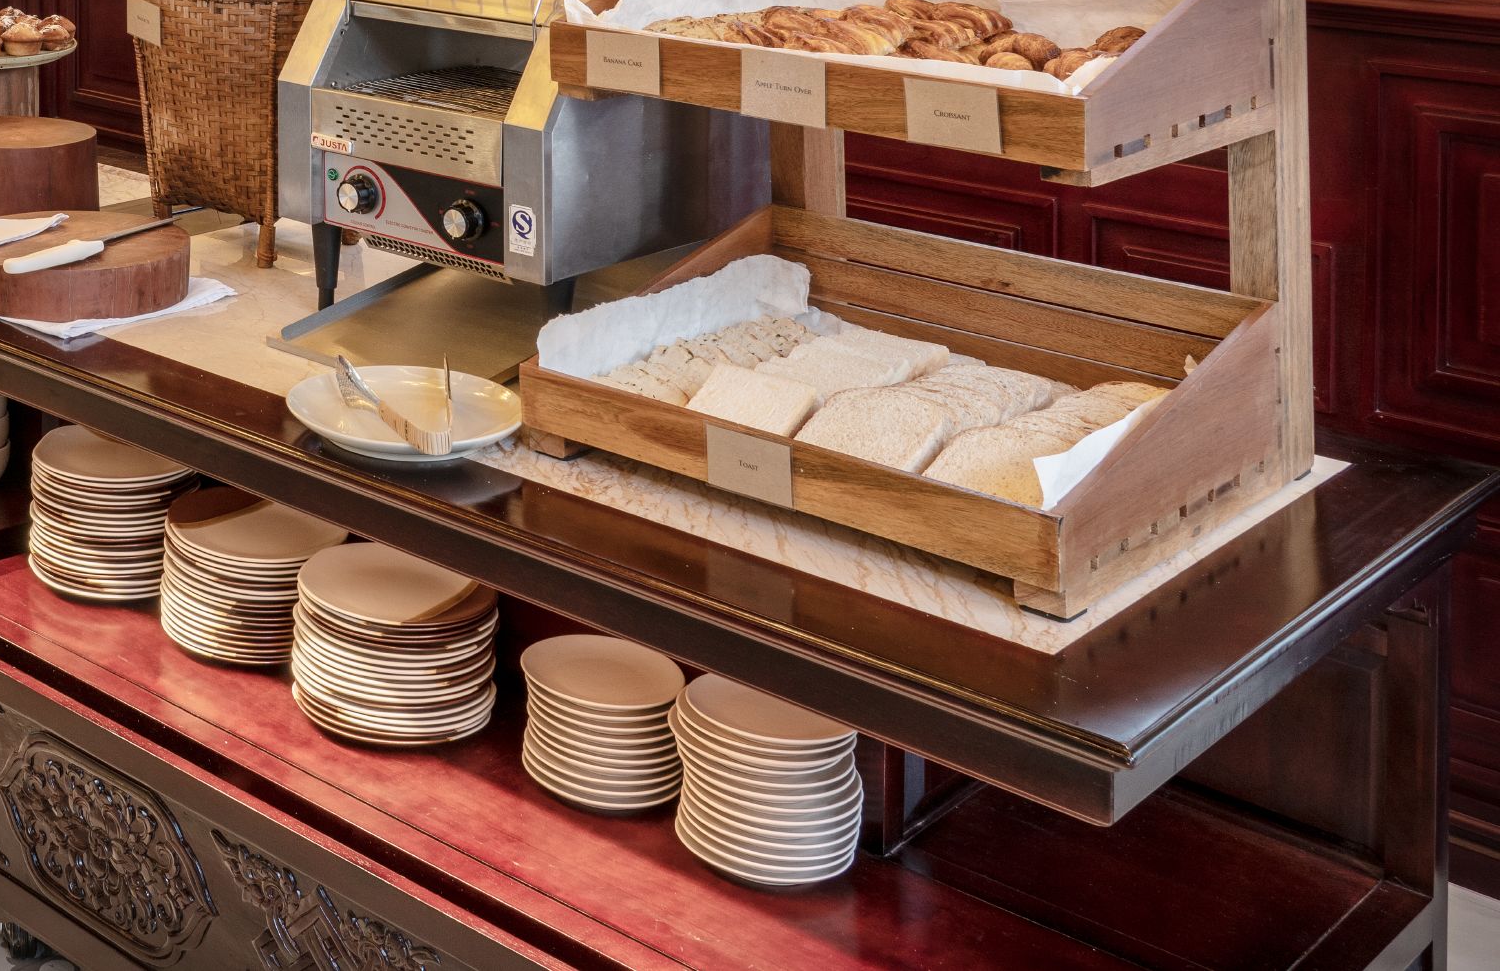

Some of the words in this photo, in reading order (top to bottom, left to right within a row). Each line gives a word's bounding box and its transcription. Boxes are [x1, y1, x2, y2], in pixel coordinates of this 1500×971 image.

[603, 56, 626, 66] BANANA
[627, 59, 643, 67] CAKE
[793, 86, 812, 95] OVER
[933, 109, 972, 122] CROISSANT
[320, 139, 347, 151] JUSTA
[738, 459, 758, 471] TOAST
